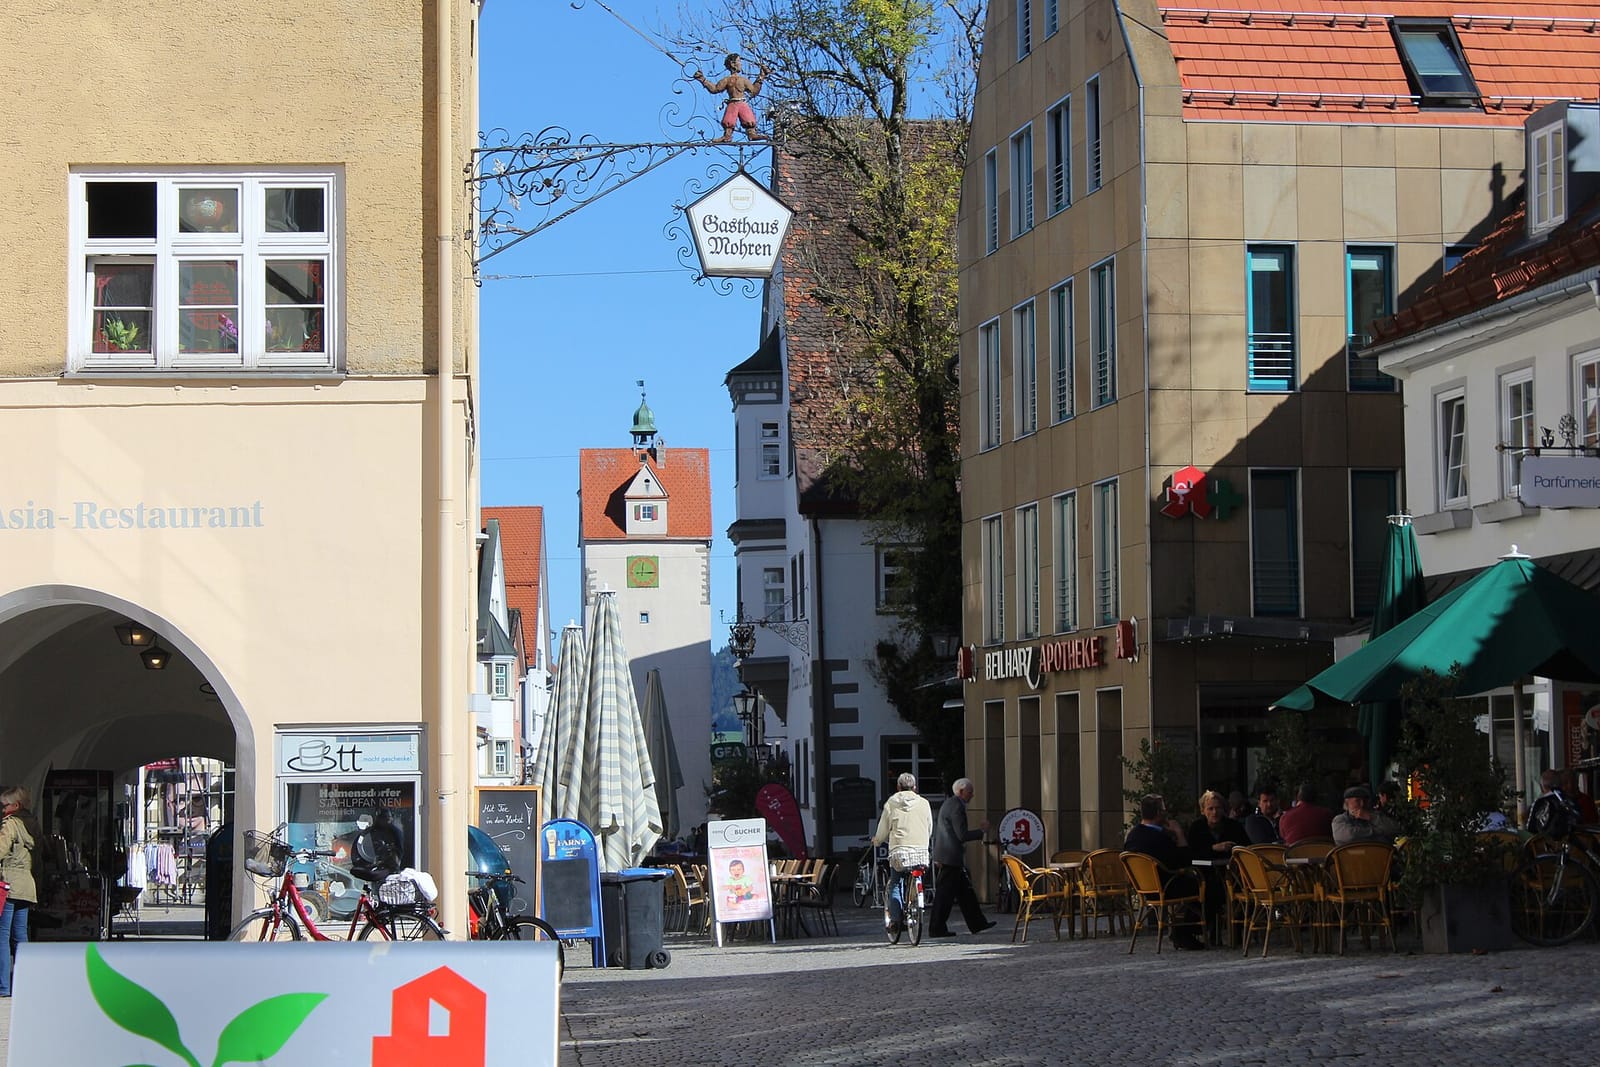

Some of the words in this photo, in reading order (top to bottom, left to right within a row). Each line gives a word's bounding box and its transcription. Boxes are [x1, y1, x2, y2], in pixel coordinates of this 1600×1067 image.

[702, 214, 779, 238] Gasthaus
[707, 236, 772, 260] Mohren
[0, 500, 265, 530] sia-Restaurant
[985, 646, 1041, 690] BEILHARZ
[1039, 636, 1099, 672] APOTHEKE
[482, 804, 495, 813] Mit
[734, 827, 761, 835] BUCHER
